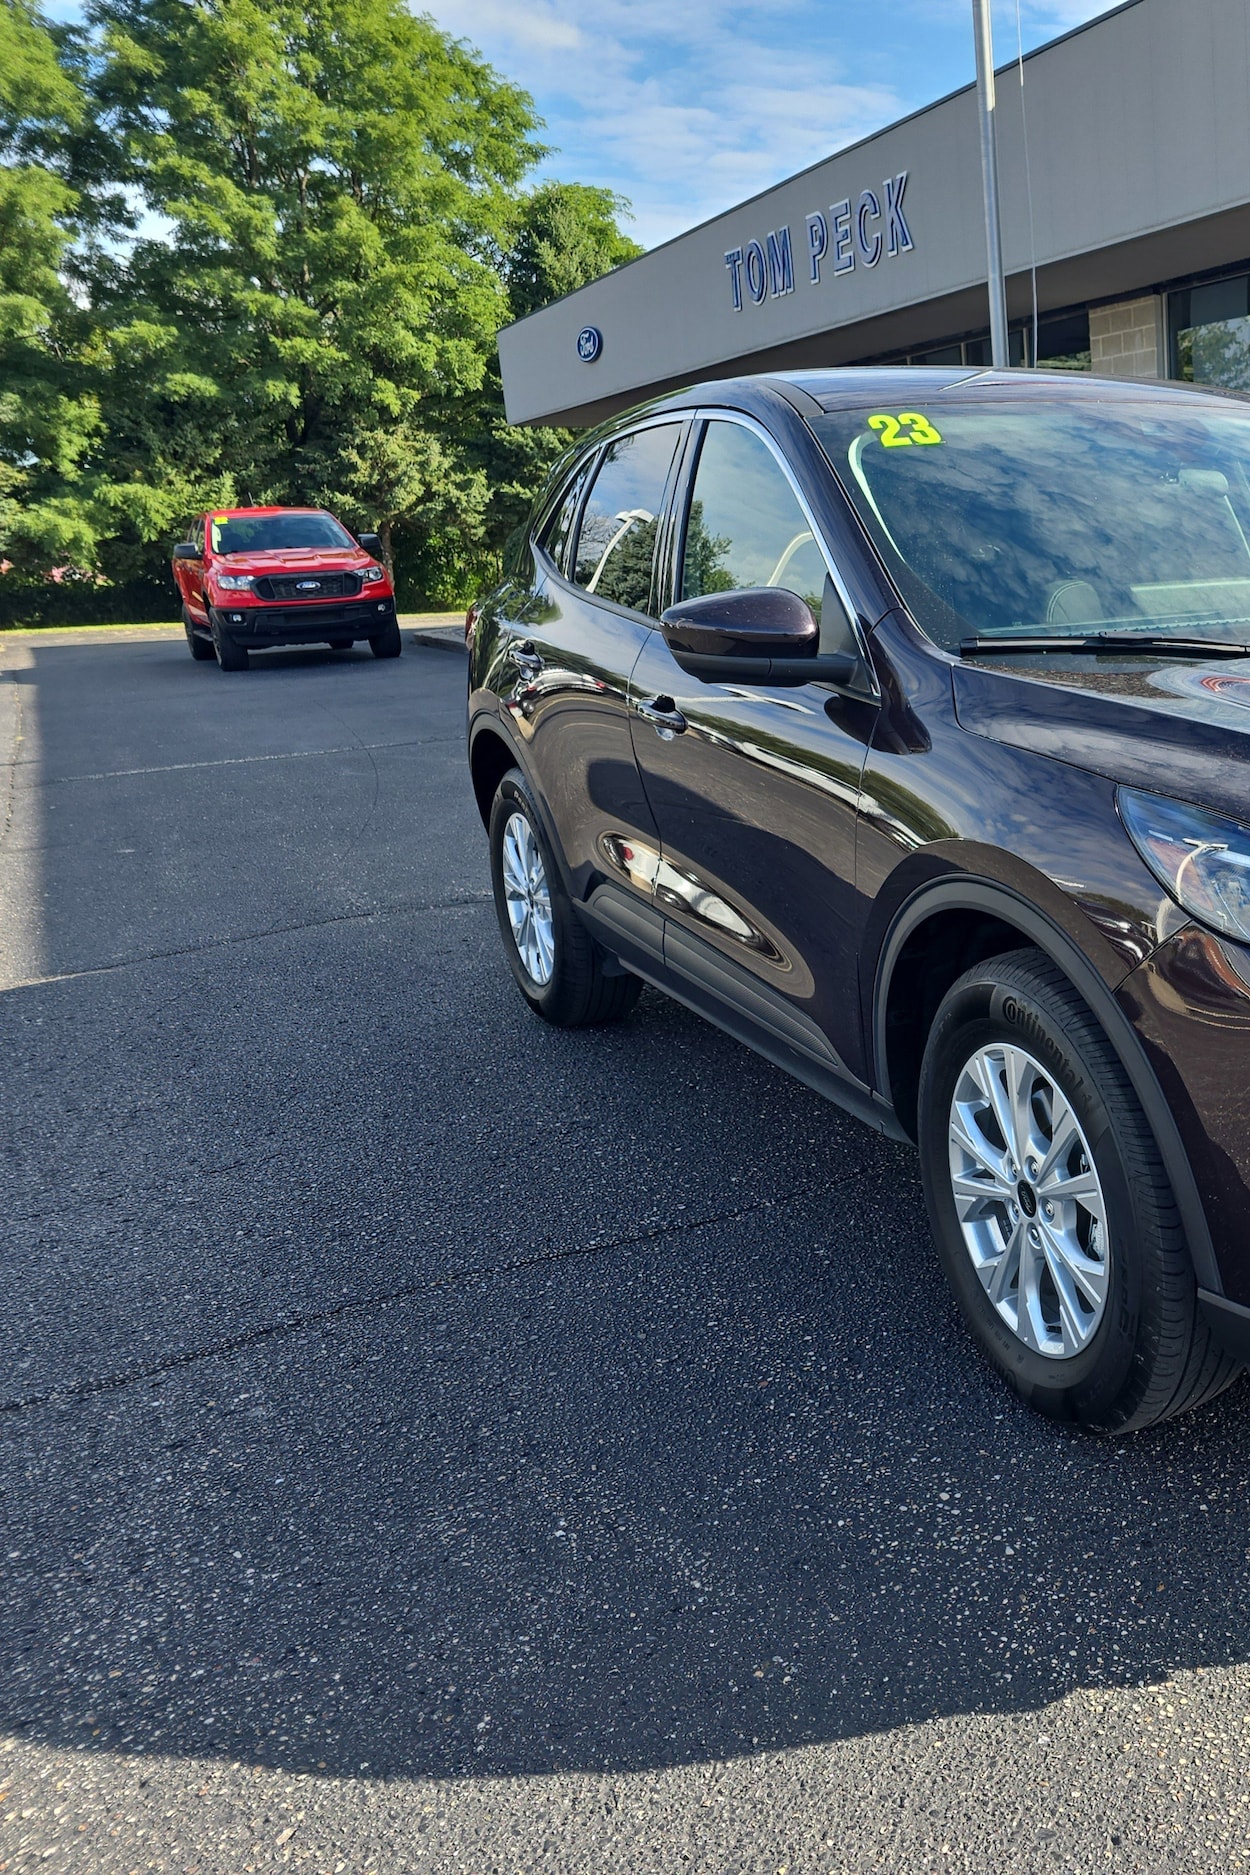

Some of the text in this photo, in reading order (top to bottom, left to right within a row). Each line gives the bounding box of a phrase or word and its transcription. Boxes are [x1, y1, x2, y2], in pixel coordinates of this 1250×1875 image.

[725, 170, 913, 312] TOM PECK
[580, 332, 594, 356] Ford
[868, 412, 942, 448] 23
[1003, 996, 1085, 1094] Continental
